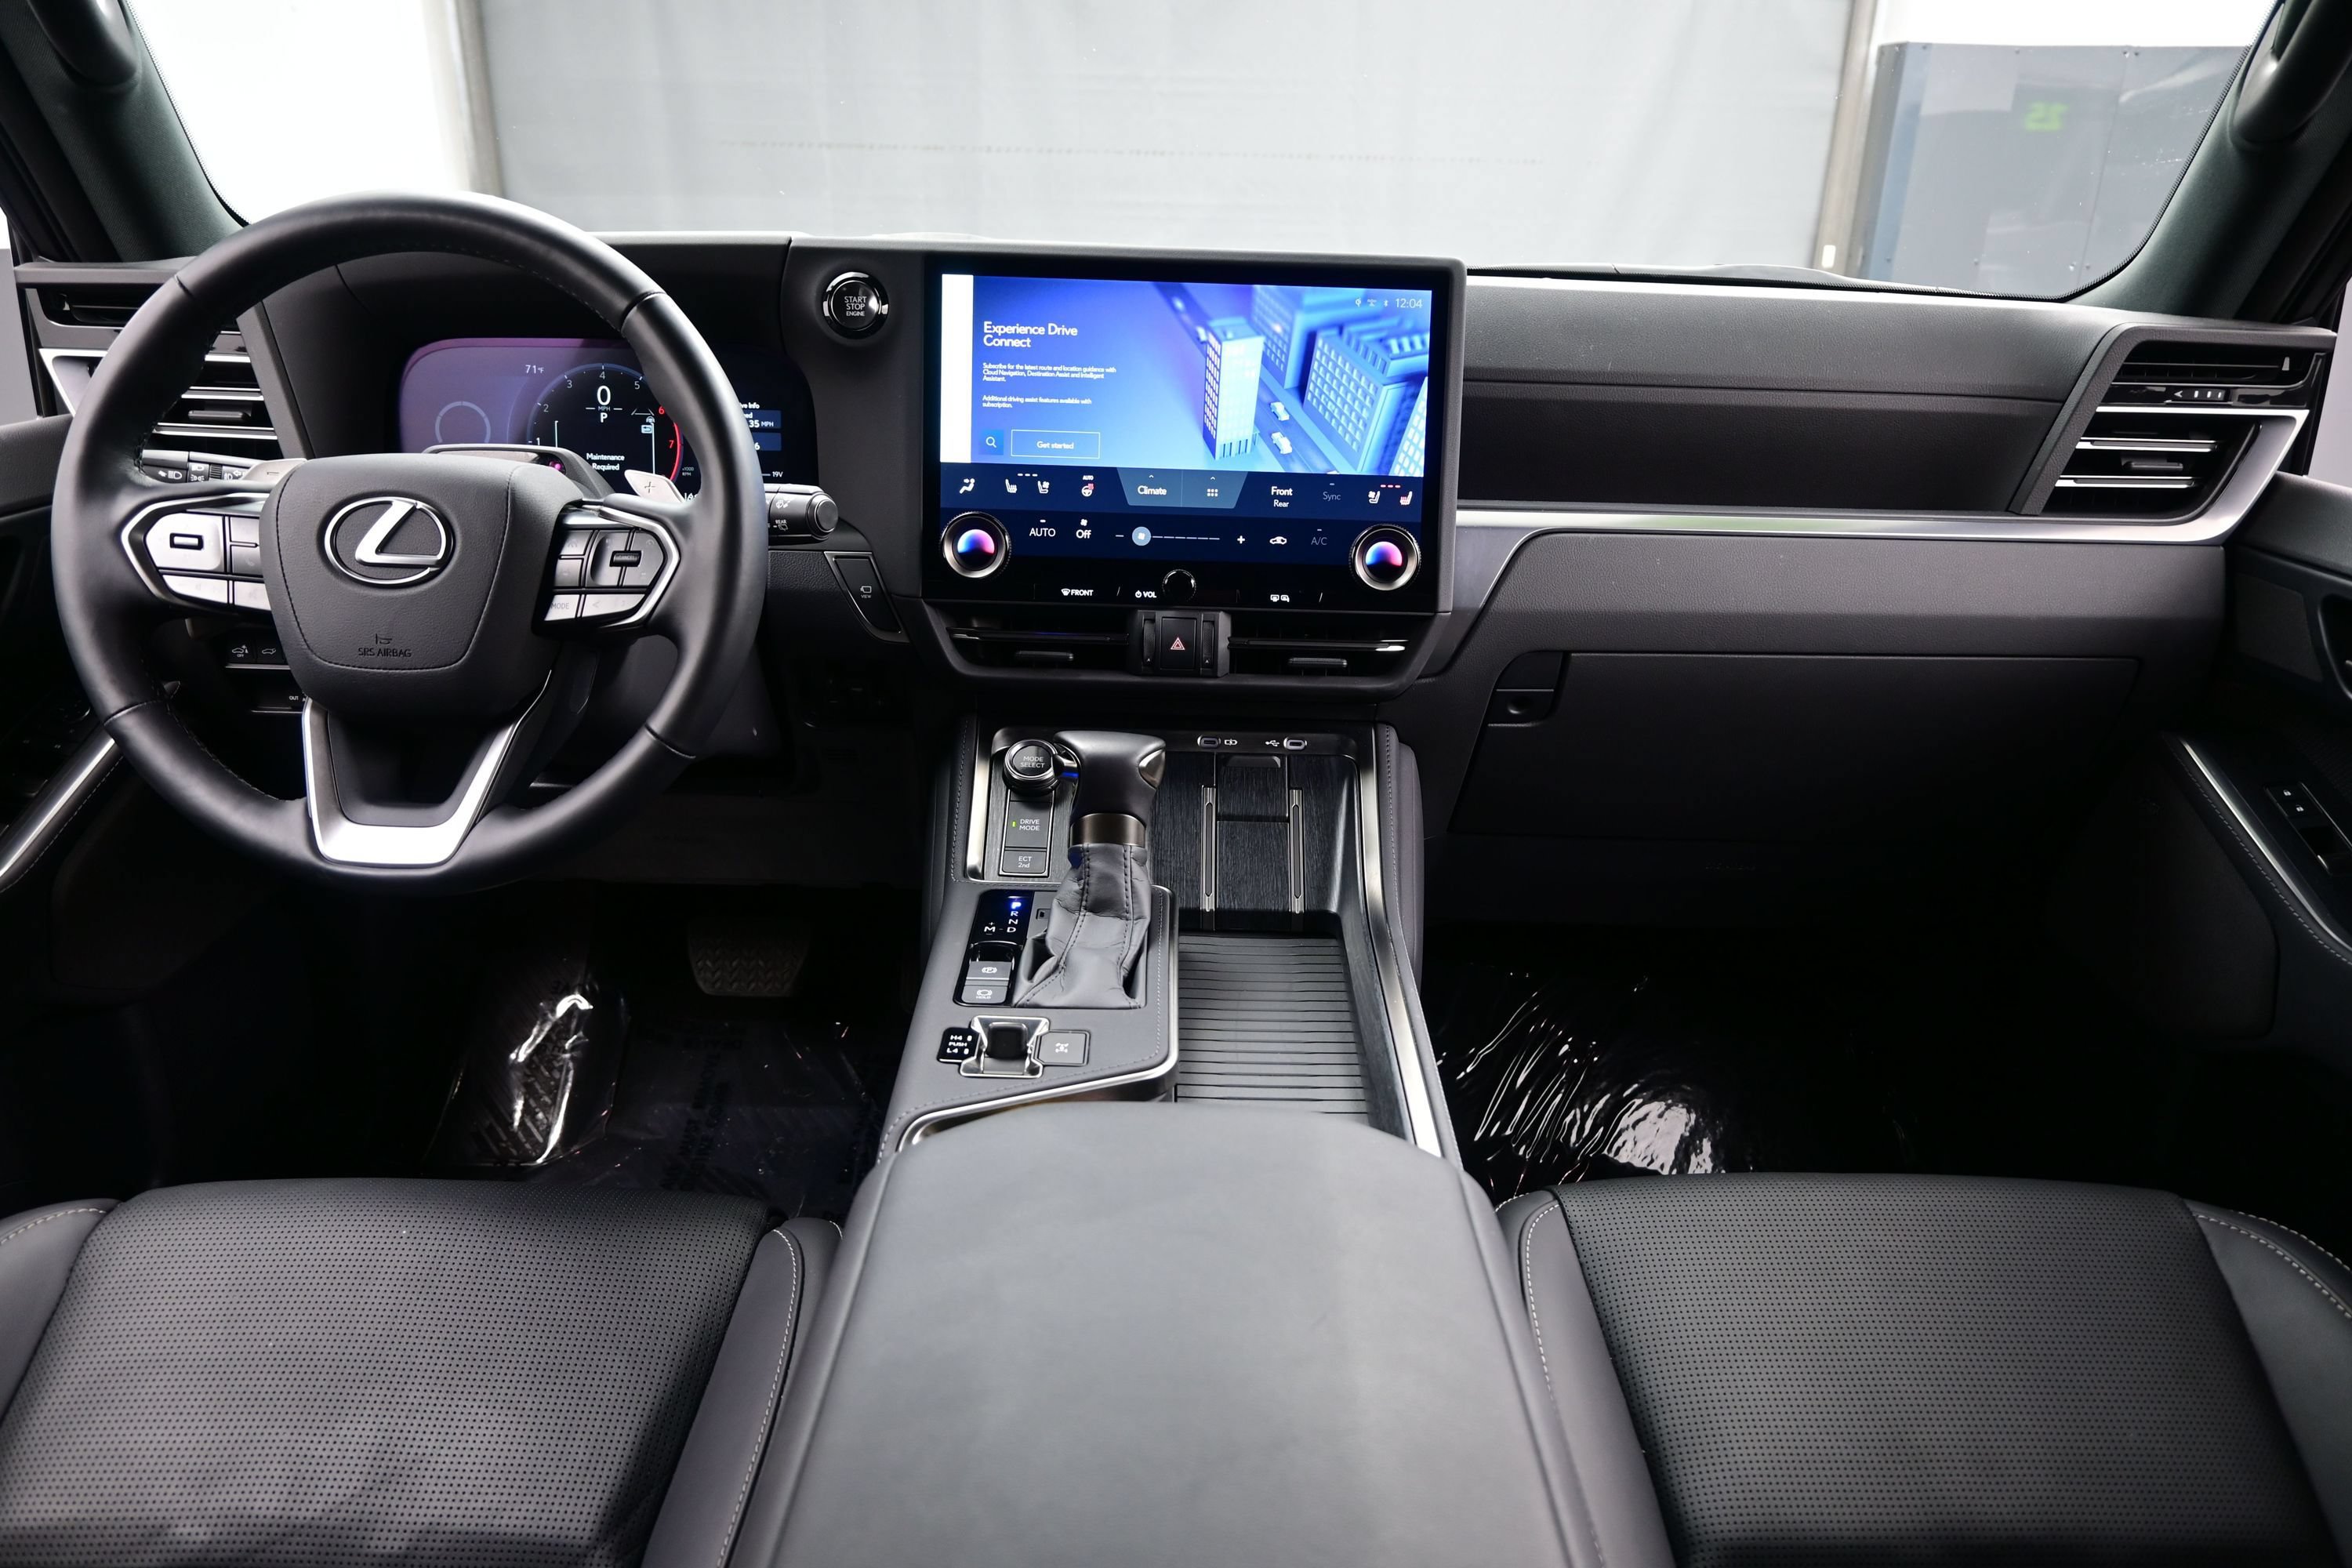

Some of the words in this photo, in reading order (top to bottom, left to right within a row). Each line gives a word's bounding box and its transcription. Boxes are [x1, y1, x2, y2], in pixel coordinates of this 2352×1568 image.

[1396, 299, 1423, 308] 12:04
[983, 321, 1046, 336] Experience
[1047, 323, 1078, 336] Drive
[983, 334, 1031, 347] Connect
[599, 371, 606, 379] 4
[567, 380, 572, 389] 3
[634, 381, 641, 390] 5
[597, 385, 612, 405] 0
[543, 404, 549, 412] 2
[659, 406, 665, 415] 6
[600, 412, 608, 423] P
[749, 419, 760, 428] 35
[669, 440, 674, 448] 7
[1036, 441, 1051, 449] Get
[1051, 441, 1074, 449] started
[586, 452, 625, 461] Maintenance
[592, 463, 619, 471] Required
[1138, 485, 1167, 495] Climate
[1271, 486, 1293, 496] Front
[1323, 491, 1341, 501] Sync
[1029, 527, 1056, 537] AUTO
[1076, 528, 1092, 539] Off
[1311, 536, 1327, 546] A/C
[358, 648, 375, 657] SRS
[377, 648, 412, 658] AIRBAG
